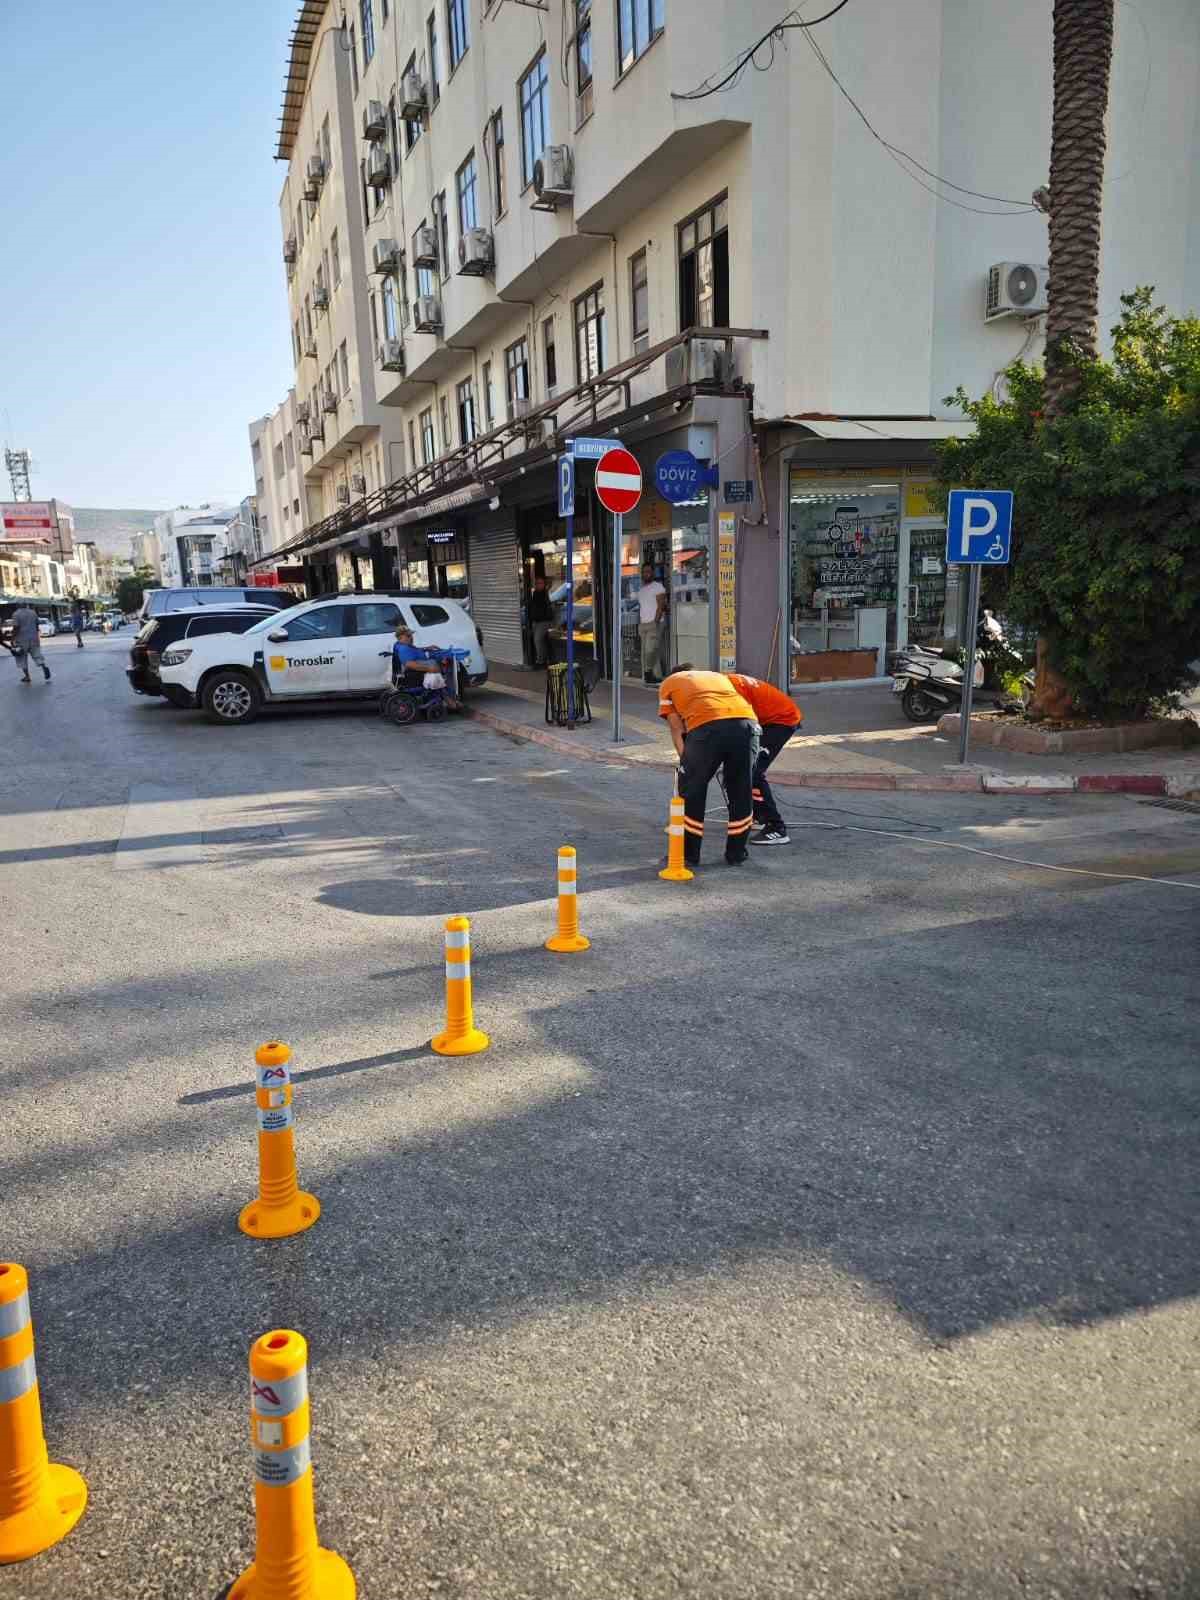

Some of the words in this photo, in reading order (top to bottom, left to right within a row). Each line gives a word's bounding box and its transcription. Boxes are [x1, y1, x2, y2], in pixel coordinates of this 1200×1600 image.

[659, 466, 697, 481] DÖVİZ
[960, 498, 998, 556] P
[286, 655, 335, 667] Toroslar
